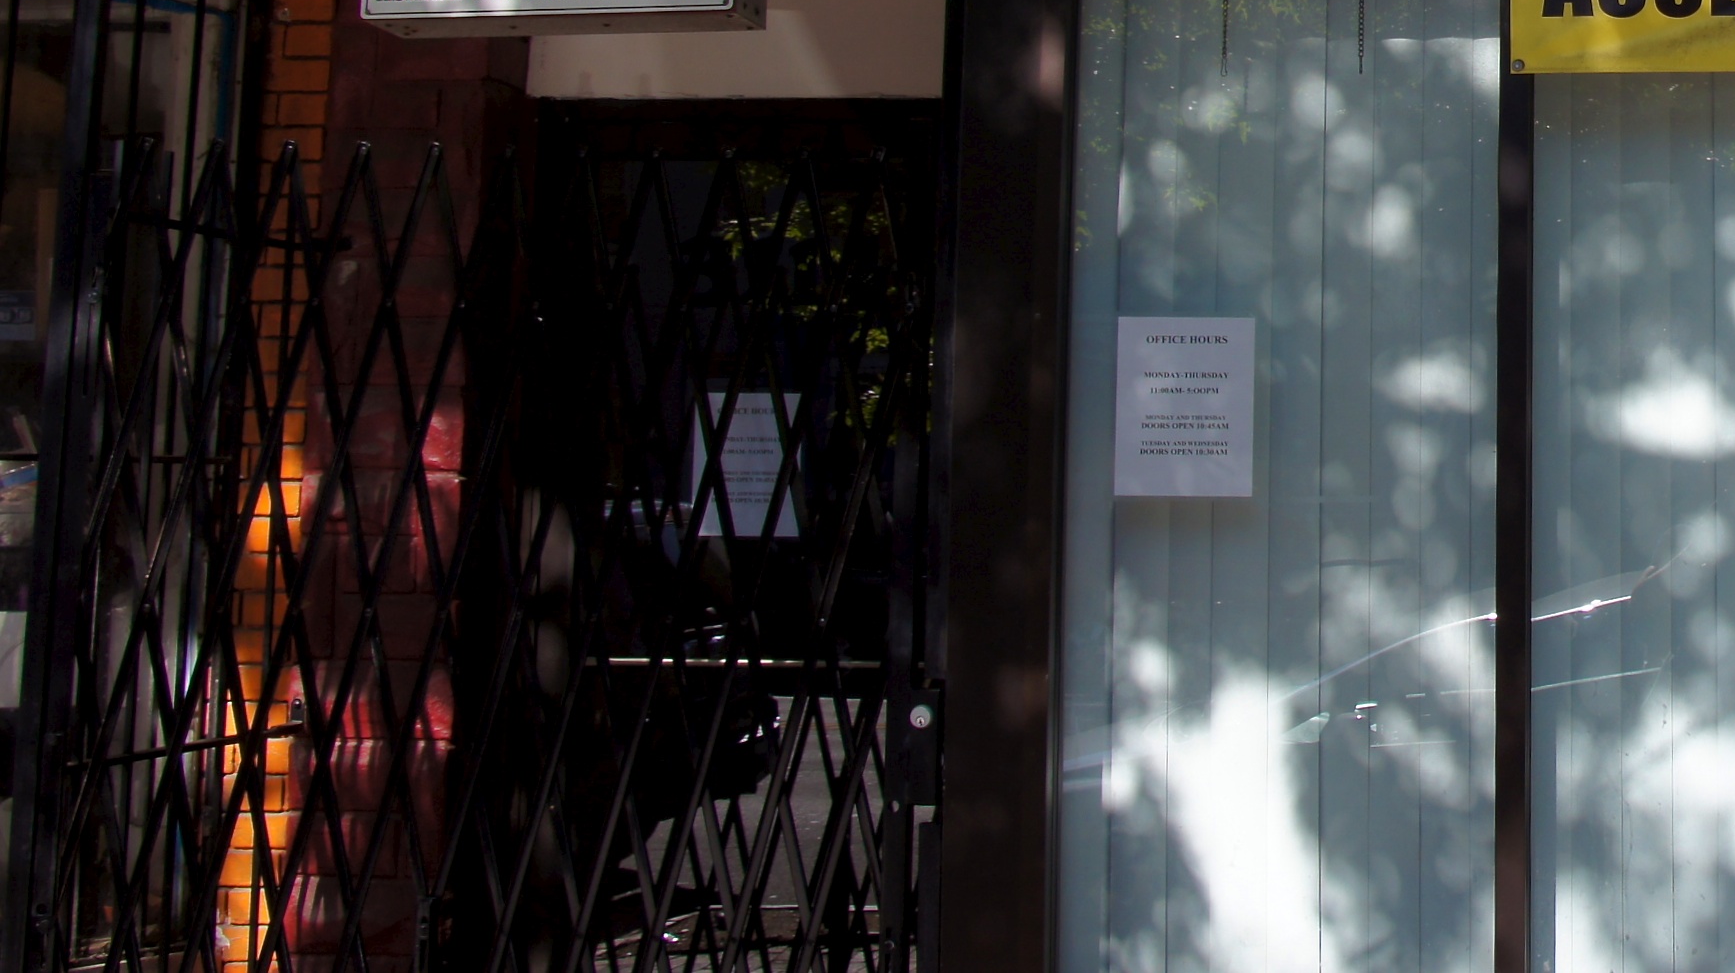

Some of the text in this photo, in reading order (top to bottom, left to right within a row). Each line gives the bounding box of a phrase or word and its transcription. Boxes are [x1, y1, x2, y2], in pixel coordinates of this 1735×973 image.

[1146, 335, 1228, 344] OFFICE HOURS
[1144, 371, 1229, 379] MONDAY-THURSDAY
[1141, 422, 1229, 430] DOORS OPEN 10:45AM
[1140, 448, 1228, 456] DOORS OPEN 10:30AM
